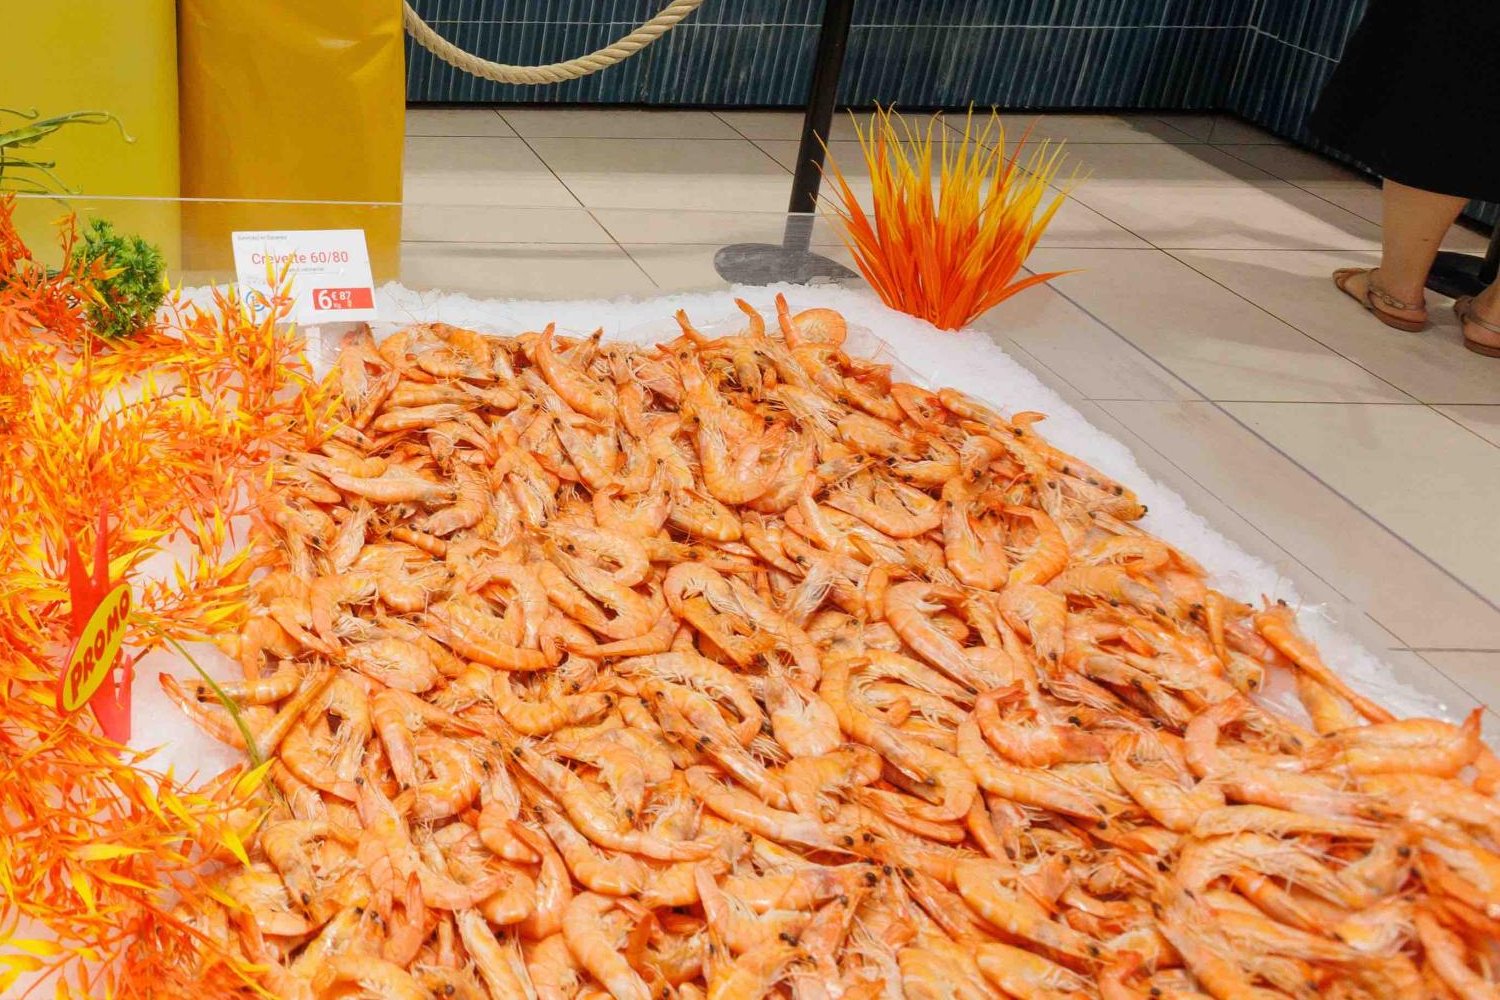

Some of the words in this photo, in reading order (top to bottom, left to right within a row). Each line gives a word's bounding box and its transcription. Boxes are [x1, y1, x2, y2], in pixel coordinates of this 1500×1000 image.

[251, 252, 307, 265] Crevete
[310, 250, 349, 264] 60/80
[318, 289, 333, 310] 6
[70, 589, 130, 705] PROMO
